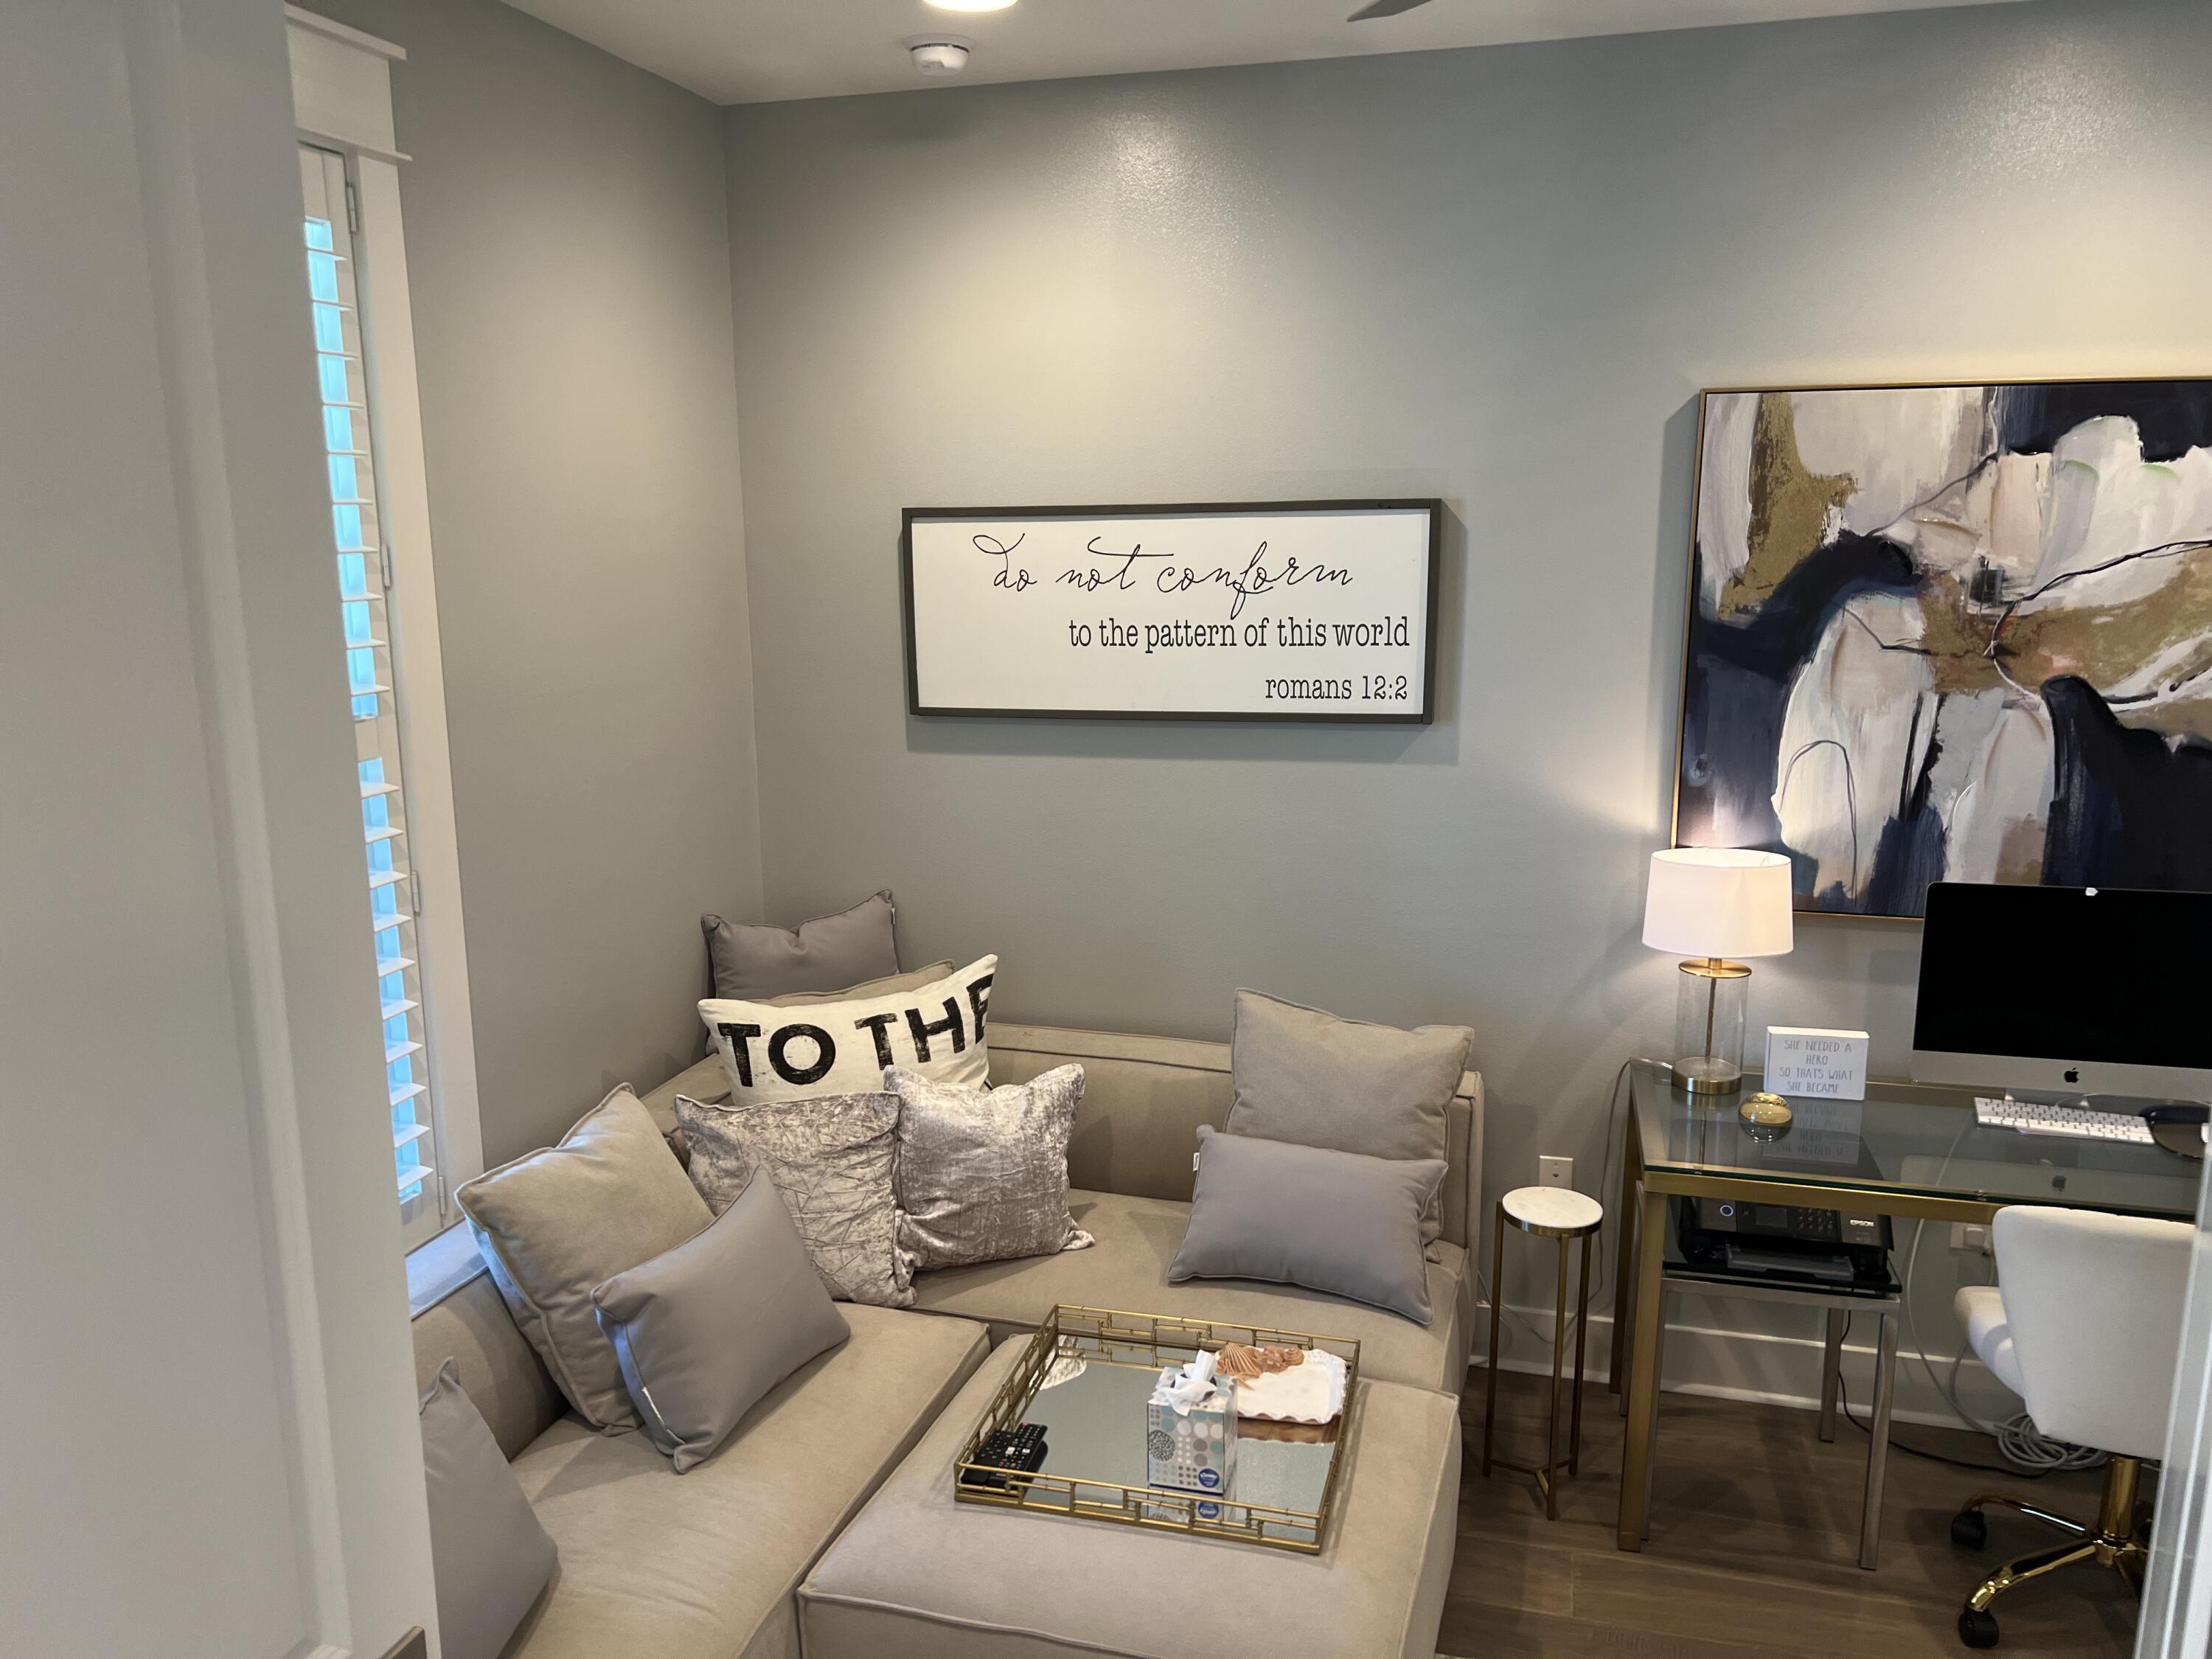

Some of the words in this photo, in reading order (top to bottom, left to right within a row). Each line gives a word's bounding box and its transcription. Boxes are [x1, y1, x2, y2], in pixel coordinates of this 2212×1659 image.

[973, 532, 1038, 592] do
[1055, 536, 1175, 592] not
[1156, 540, 1353, 621] conform
[1068, 619, 1092, 647] to
[1099, 617, 1138, 647] the
[1144, 619, 1237, 654] pattern
[1244, 616, 1270, 647] of
[1276, 616, 1326, 647] this
[1332, 616, 1411, 647] world
[1265, 678, 1352, 700] romans
[1361, 675, 1408, 700] 12:2
[717, 1022, 836, 1088] TO
[1784, 1039, 1800, 1050] SHE
[1806, 1040, 1840, 1052] NEEDED
[1845, 1043, 1852, 1053] A
[1806, 1054, 1829, 1065] HERO
[1779, 1067, 1791, 1077] SO
[1829, 1070, 1853, 1081] WHAT
[1787, 1081, 1801, 1092] SHE
[1806, 1082, 1839, 1093] BECAME
